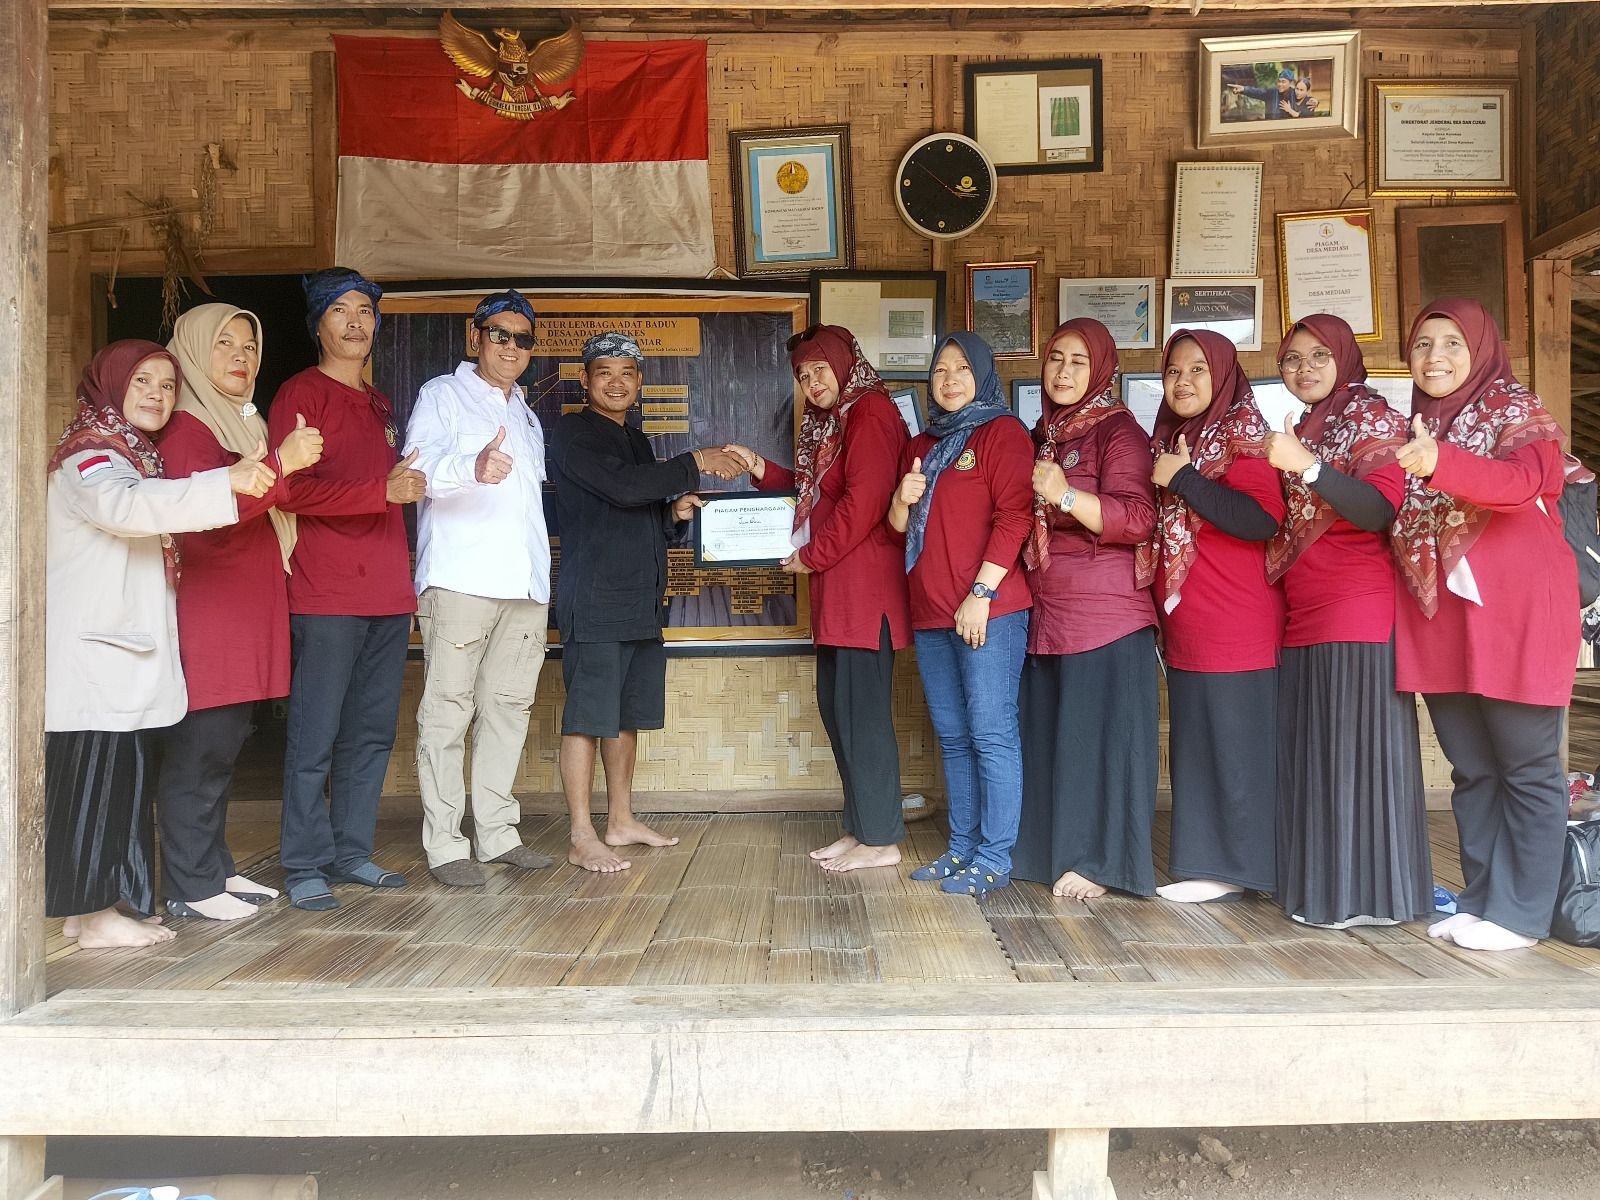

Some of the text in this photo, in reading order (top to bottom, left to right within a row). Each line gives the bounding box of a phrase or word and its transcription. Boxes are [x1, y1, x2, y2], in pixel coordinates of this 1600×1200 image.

[534, 320, 678, 328] UKTUR LEMBAGA ADAT BADUY
[535, 338, 586, 346] KECAMATA
